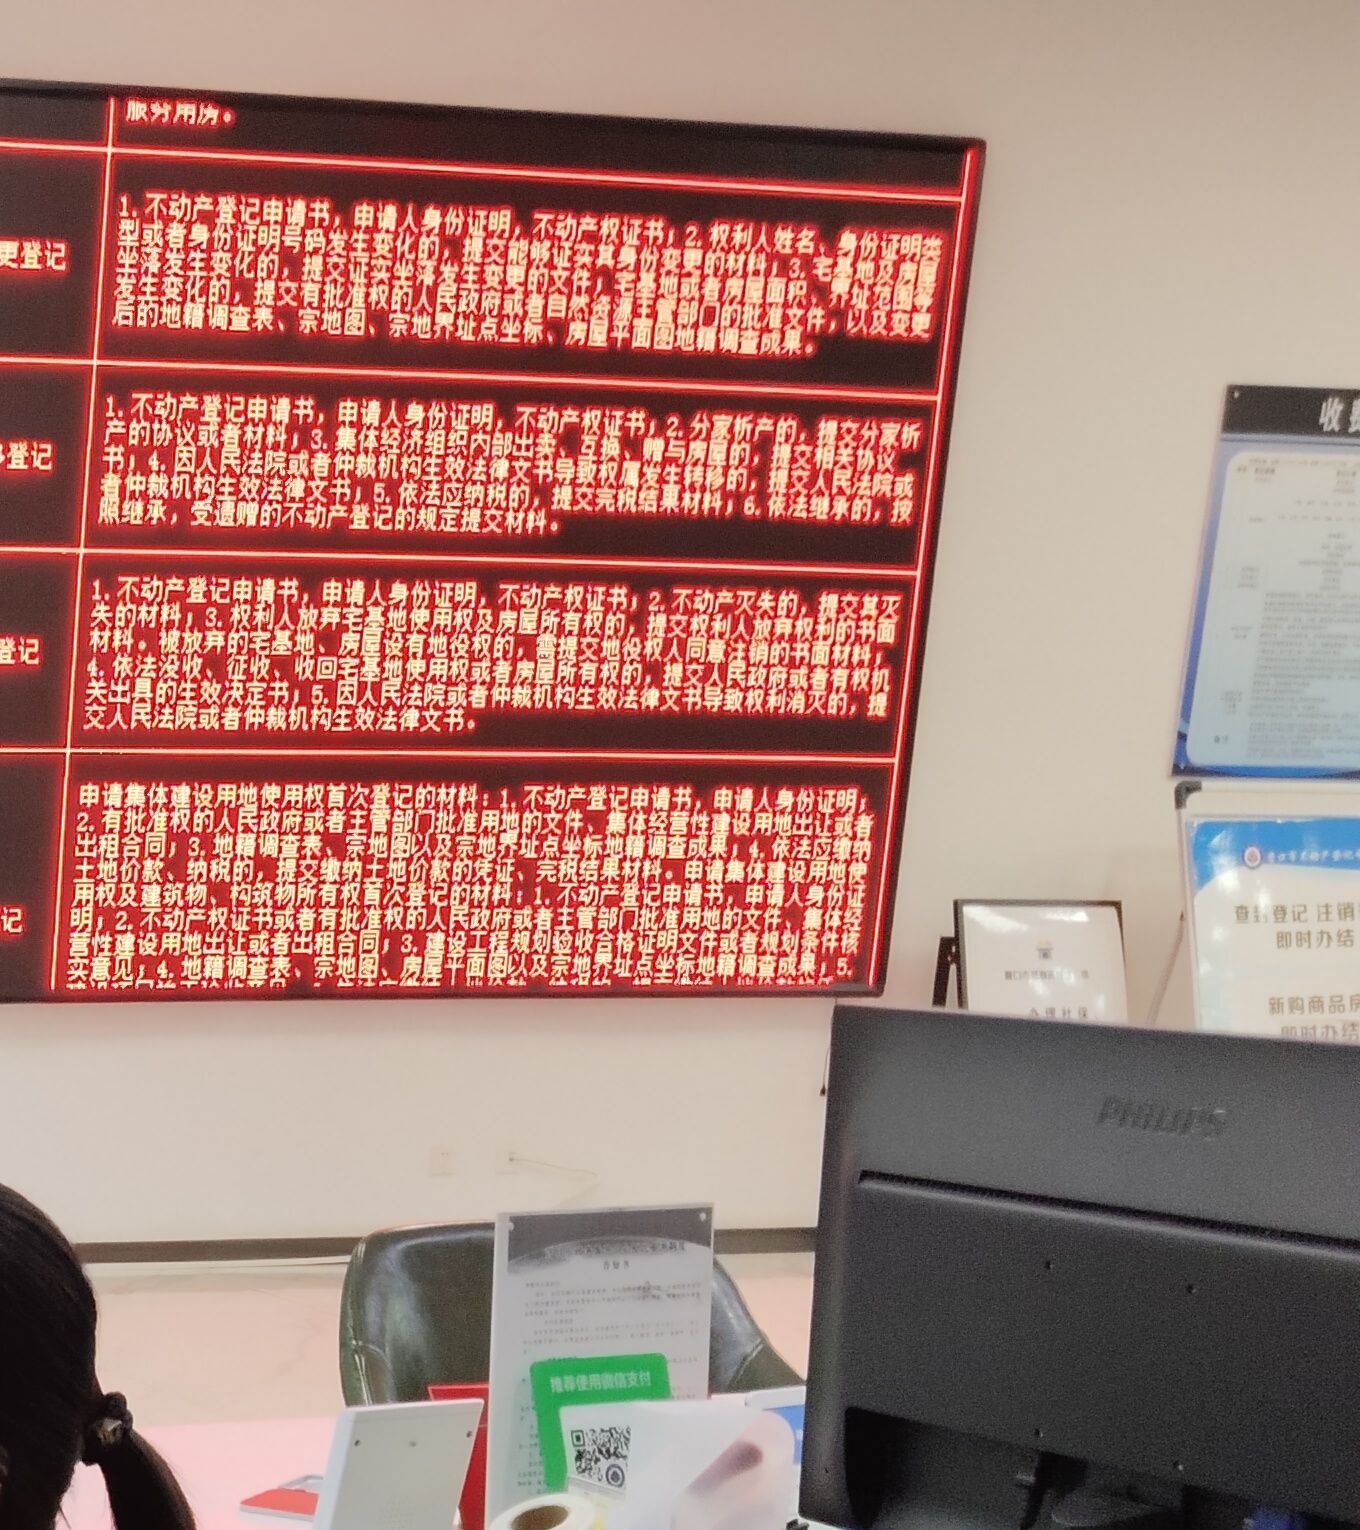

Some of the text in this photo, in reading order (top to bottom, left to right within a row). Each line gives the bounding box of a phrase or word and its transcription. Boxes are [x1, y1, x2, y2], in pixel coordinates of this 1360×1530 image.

[1316, 901, 1360, 923] 注销
[1276, 928, 1355, 950] 即时办结
